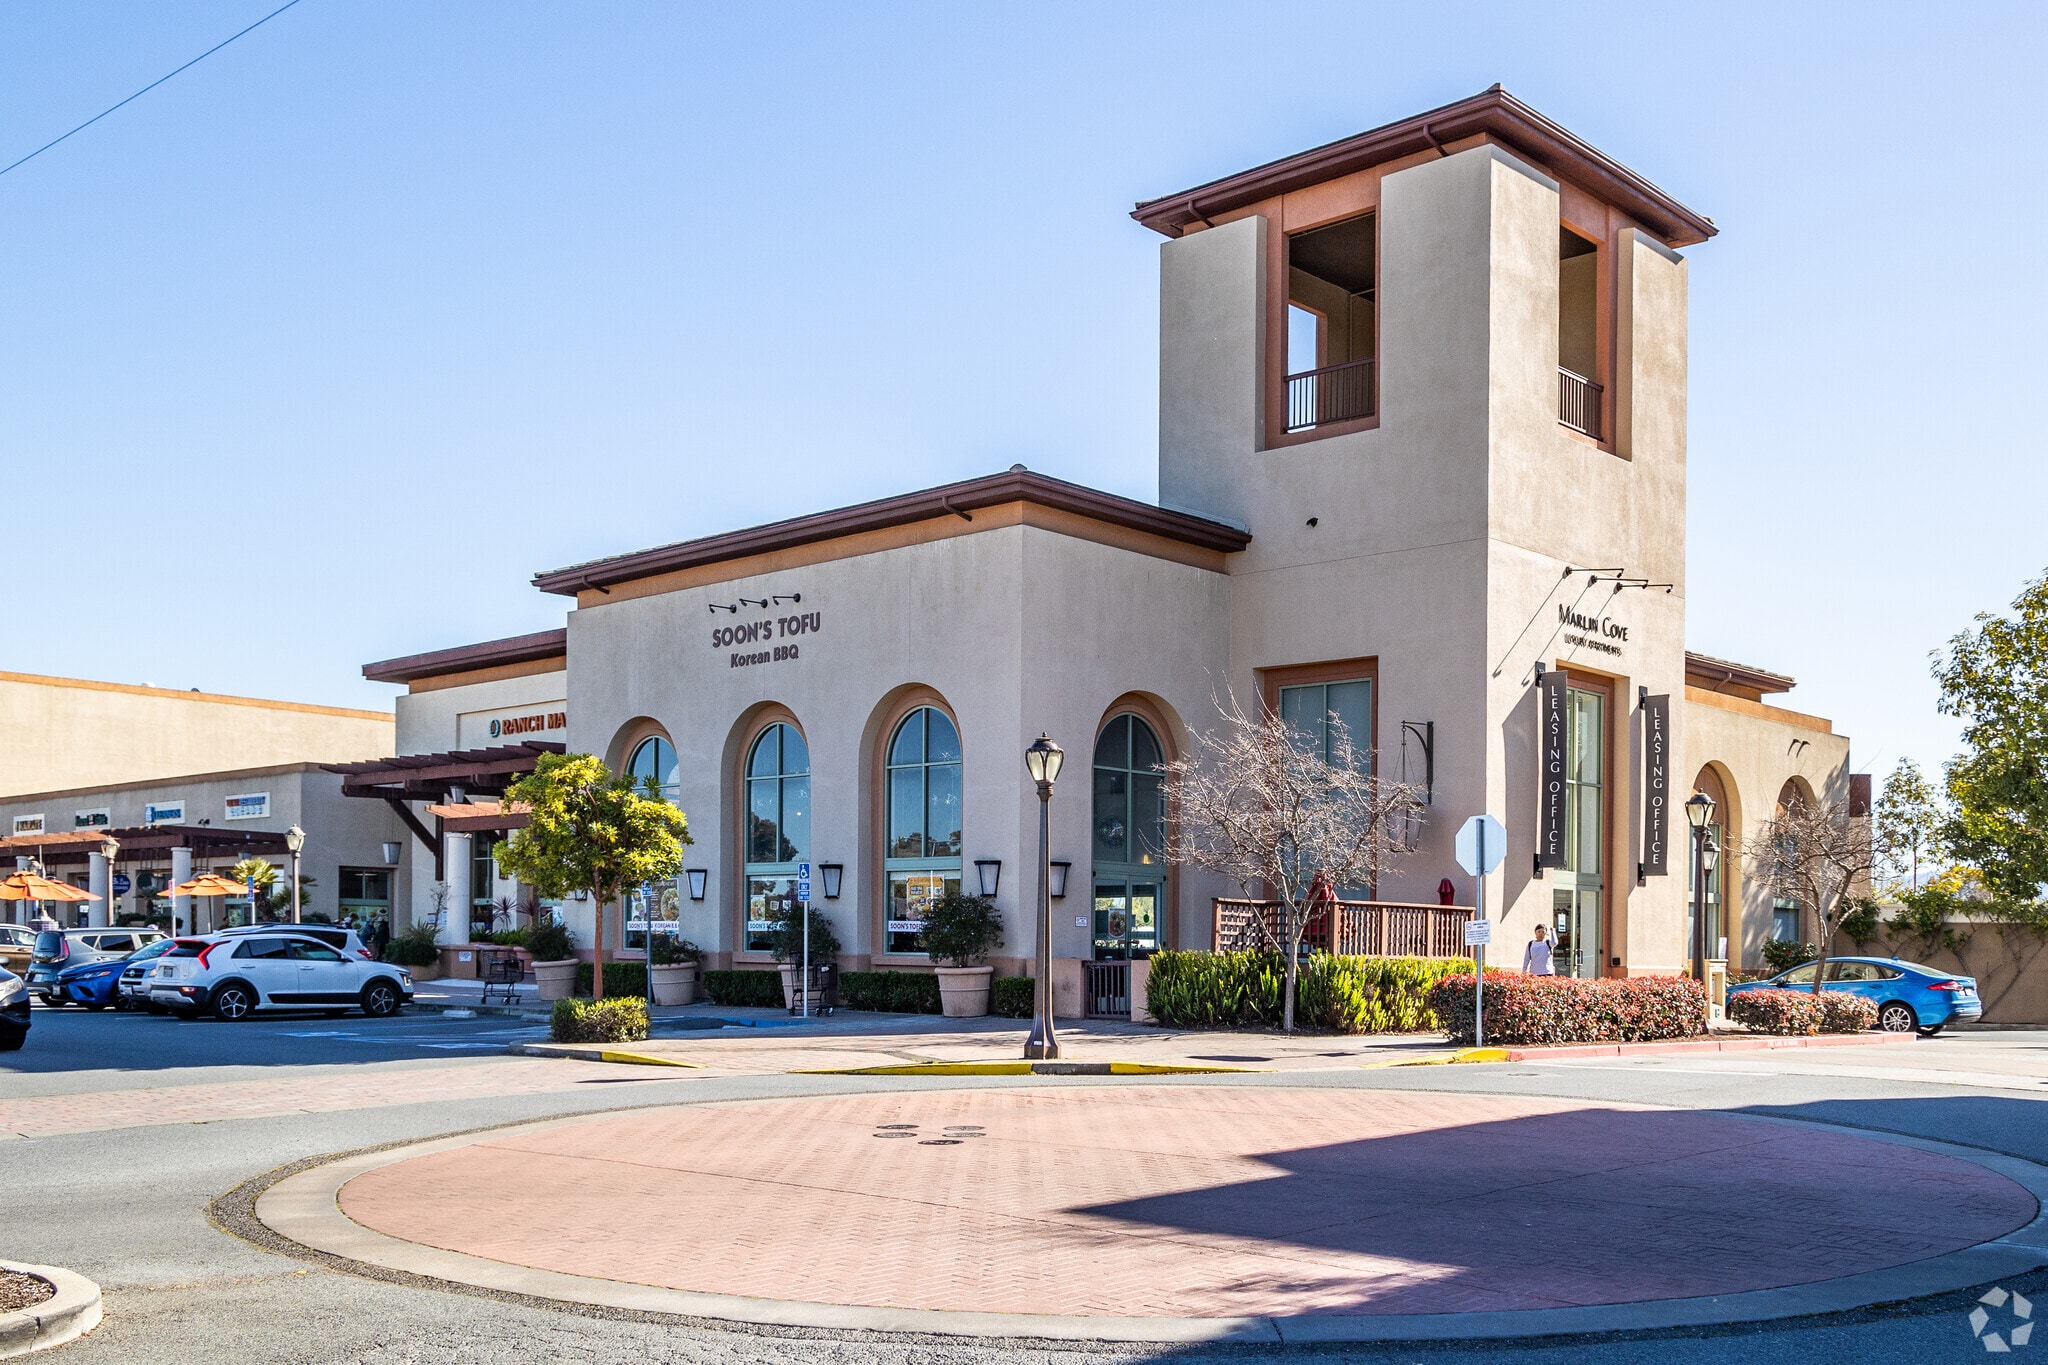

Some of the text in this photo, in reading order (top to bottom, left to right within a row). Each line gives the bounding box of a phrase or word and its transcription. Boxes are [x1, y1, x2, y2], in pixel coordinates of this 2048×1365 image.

[712, 611, 821, 648] SOON'S TOFU
[1602, 616, 1629, 642] COVE
[730, 643, 799, 668] Korean BBQ
[502, 714, 545, 736] RANCH
[1549, 685, 1560, 855] LEASING OFFICE
[1651, 707, 1663, 865] LEASING OFFICE
